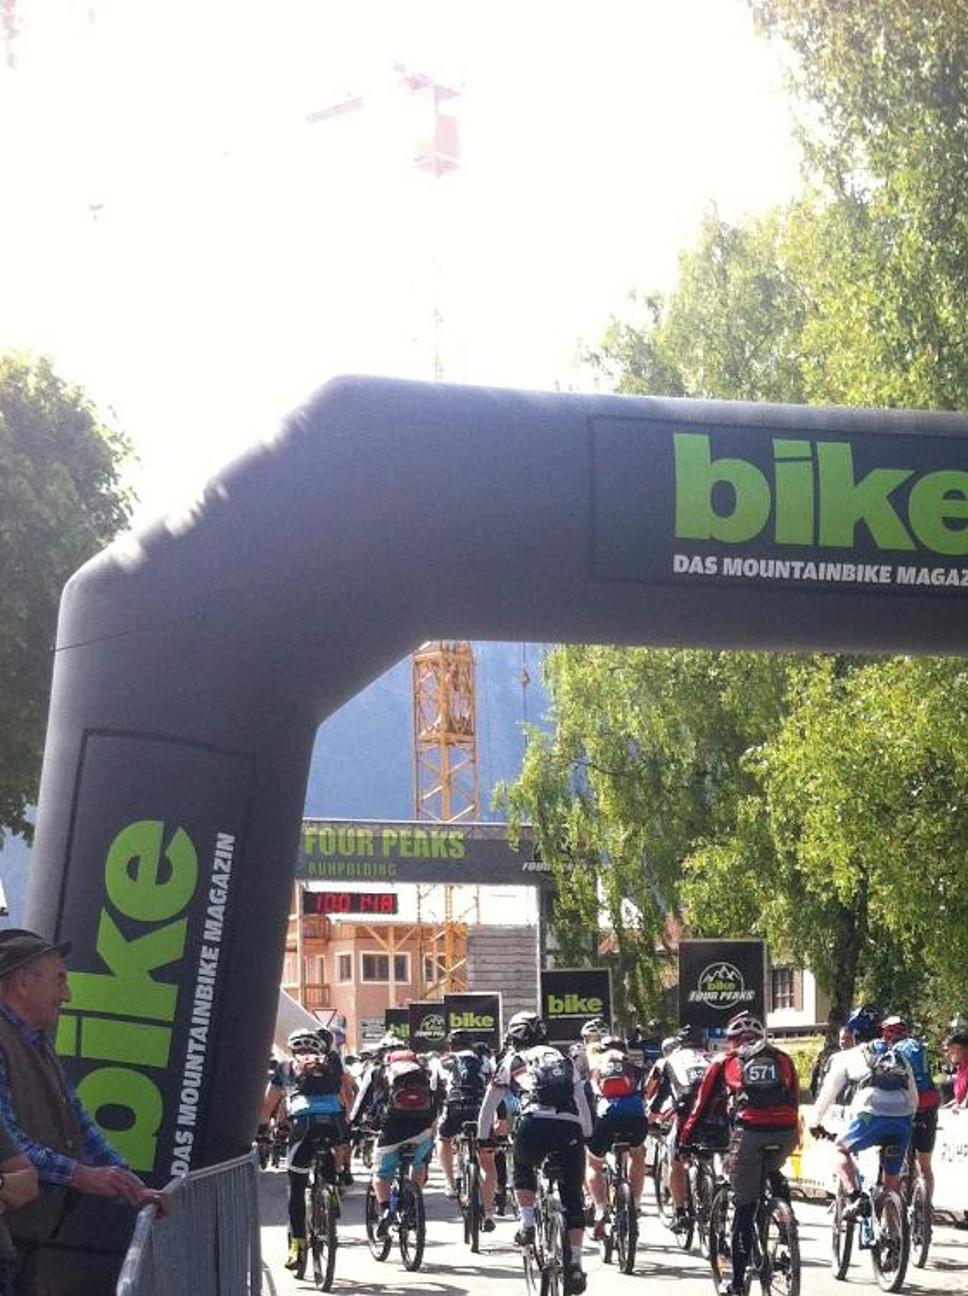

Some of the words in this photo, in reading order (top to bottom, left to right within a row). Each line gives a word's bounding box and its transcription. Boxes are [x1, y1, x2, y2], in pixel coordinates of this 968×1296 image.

[673, 553, 718, 576] DAS
[722, 556, 893, 585] MOUNTAINBIKE
[304, 826, 375, 857] FOUR
[381, 827, 466, 859] PEAKS
[205, 831, 237, 943] MAGAZIN
[55, 819, 199, 1173] bike
[547, 994, 604, 1014] bike
[177, 943, 221, 1126] MOUNTAINBIKE
[449, 1012, 495, 1028] bike
[749, 1064, 776, 1082] 571
[170, 1130, 194, 1178] DAS
